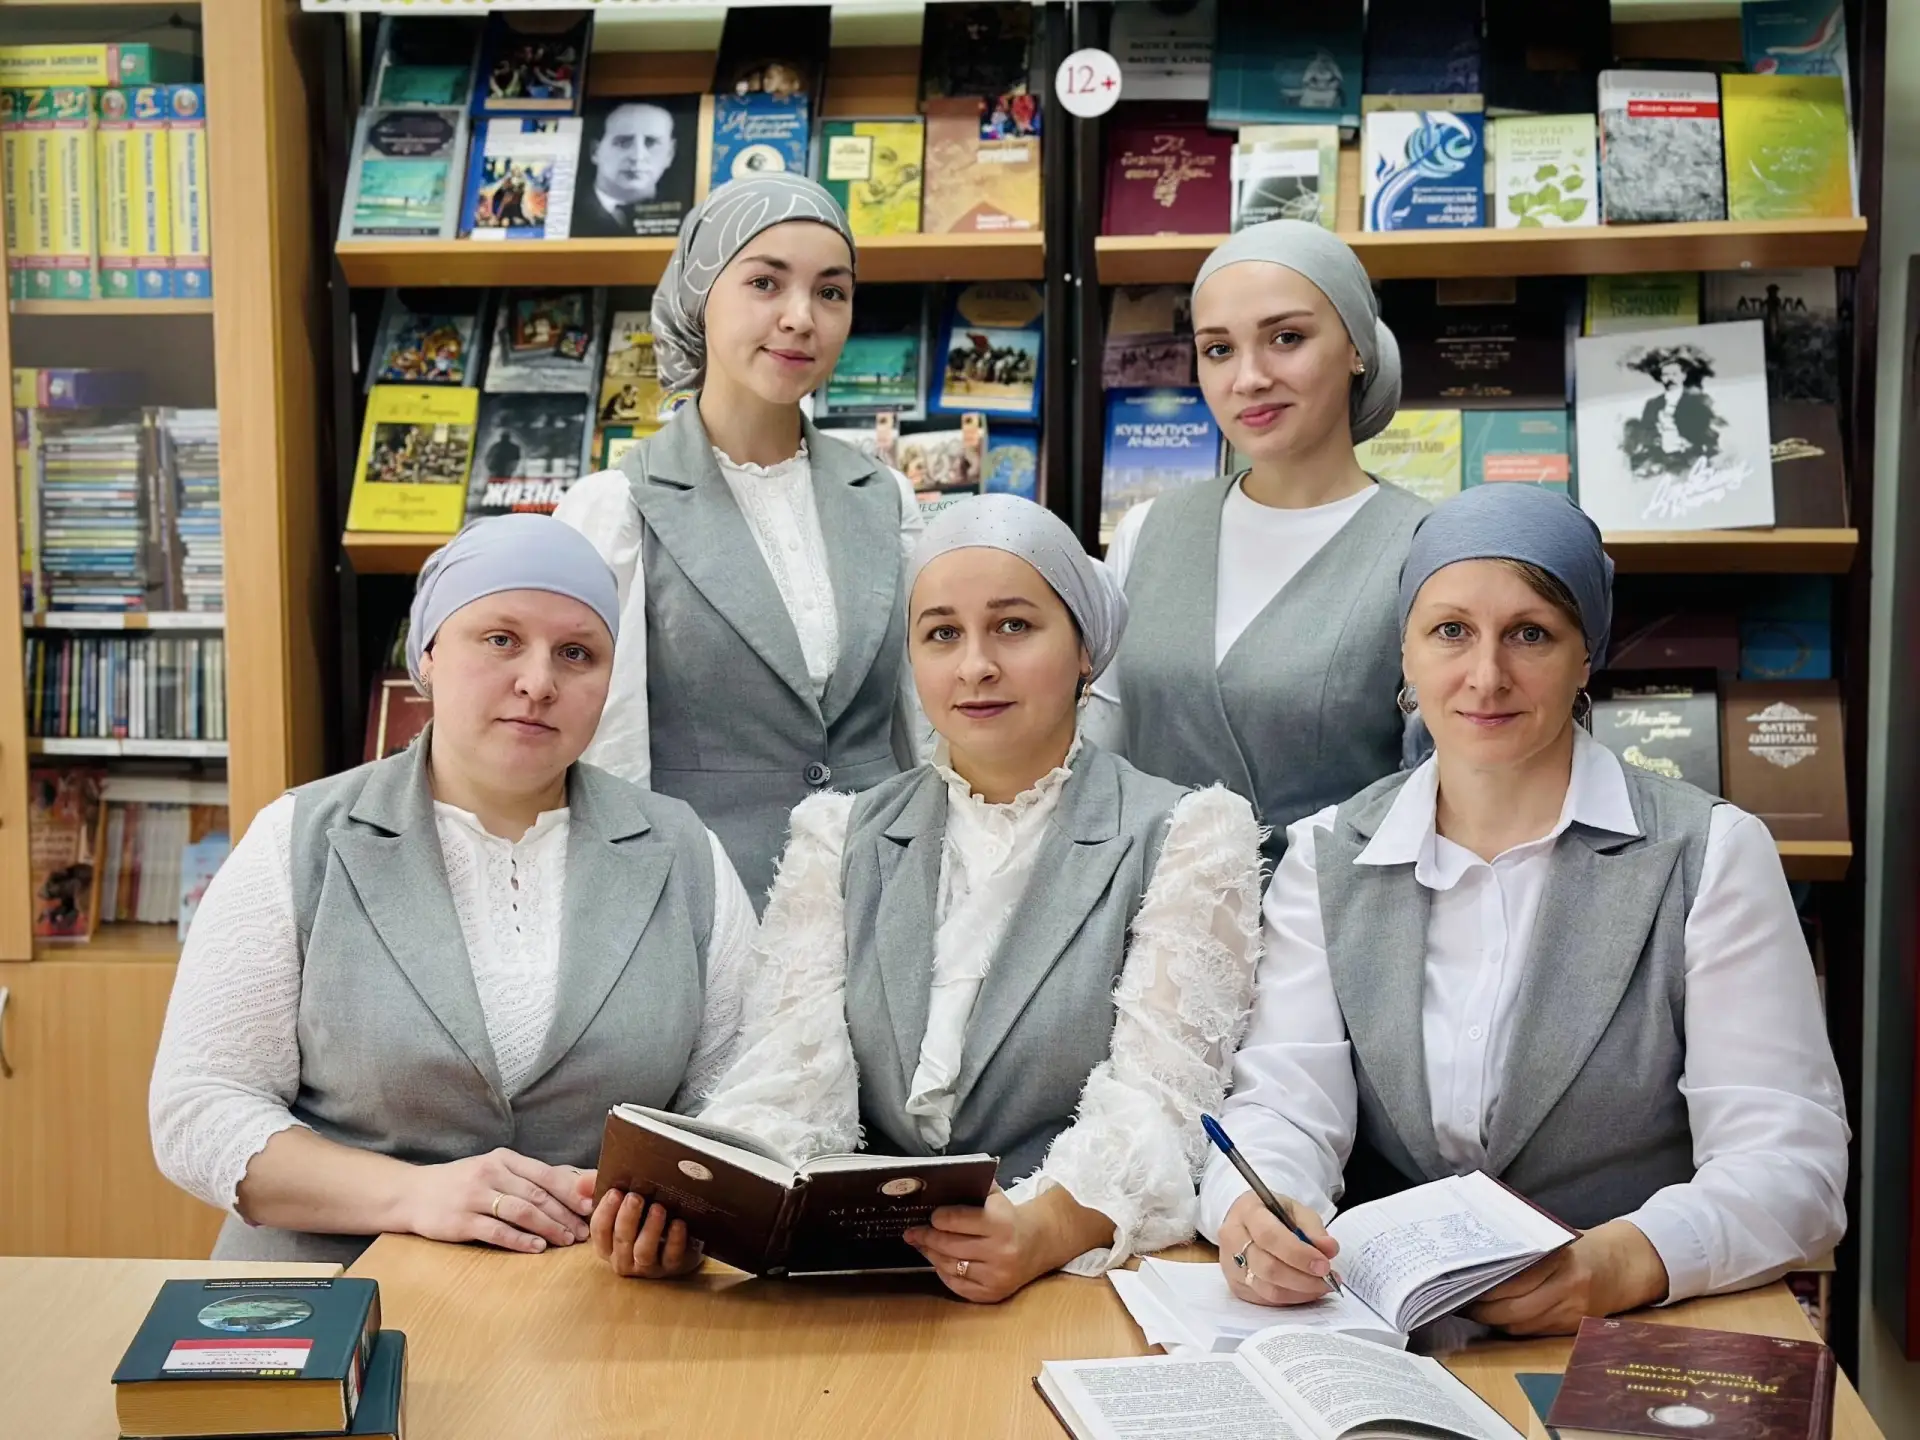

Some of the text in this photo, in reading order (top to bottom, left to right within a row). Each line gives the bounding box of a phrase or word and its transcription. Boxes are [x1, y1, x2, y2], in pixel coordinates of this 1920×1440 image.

[1065, 65, 1117, 95] 12+
[1758, 722, 1806, 733] ФАТИХ
[883, 1203, 937, 1213] Лермо
[1626, 1383, 1751, 1404] И. А. Бунин
